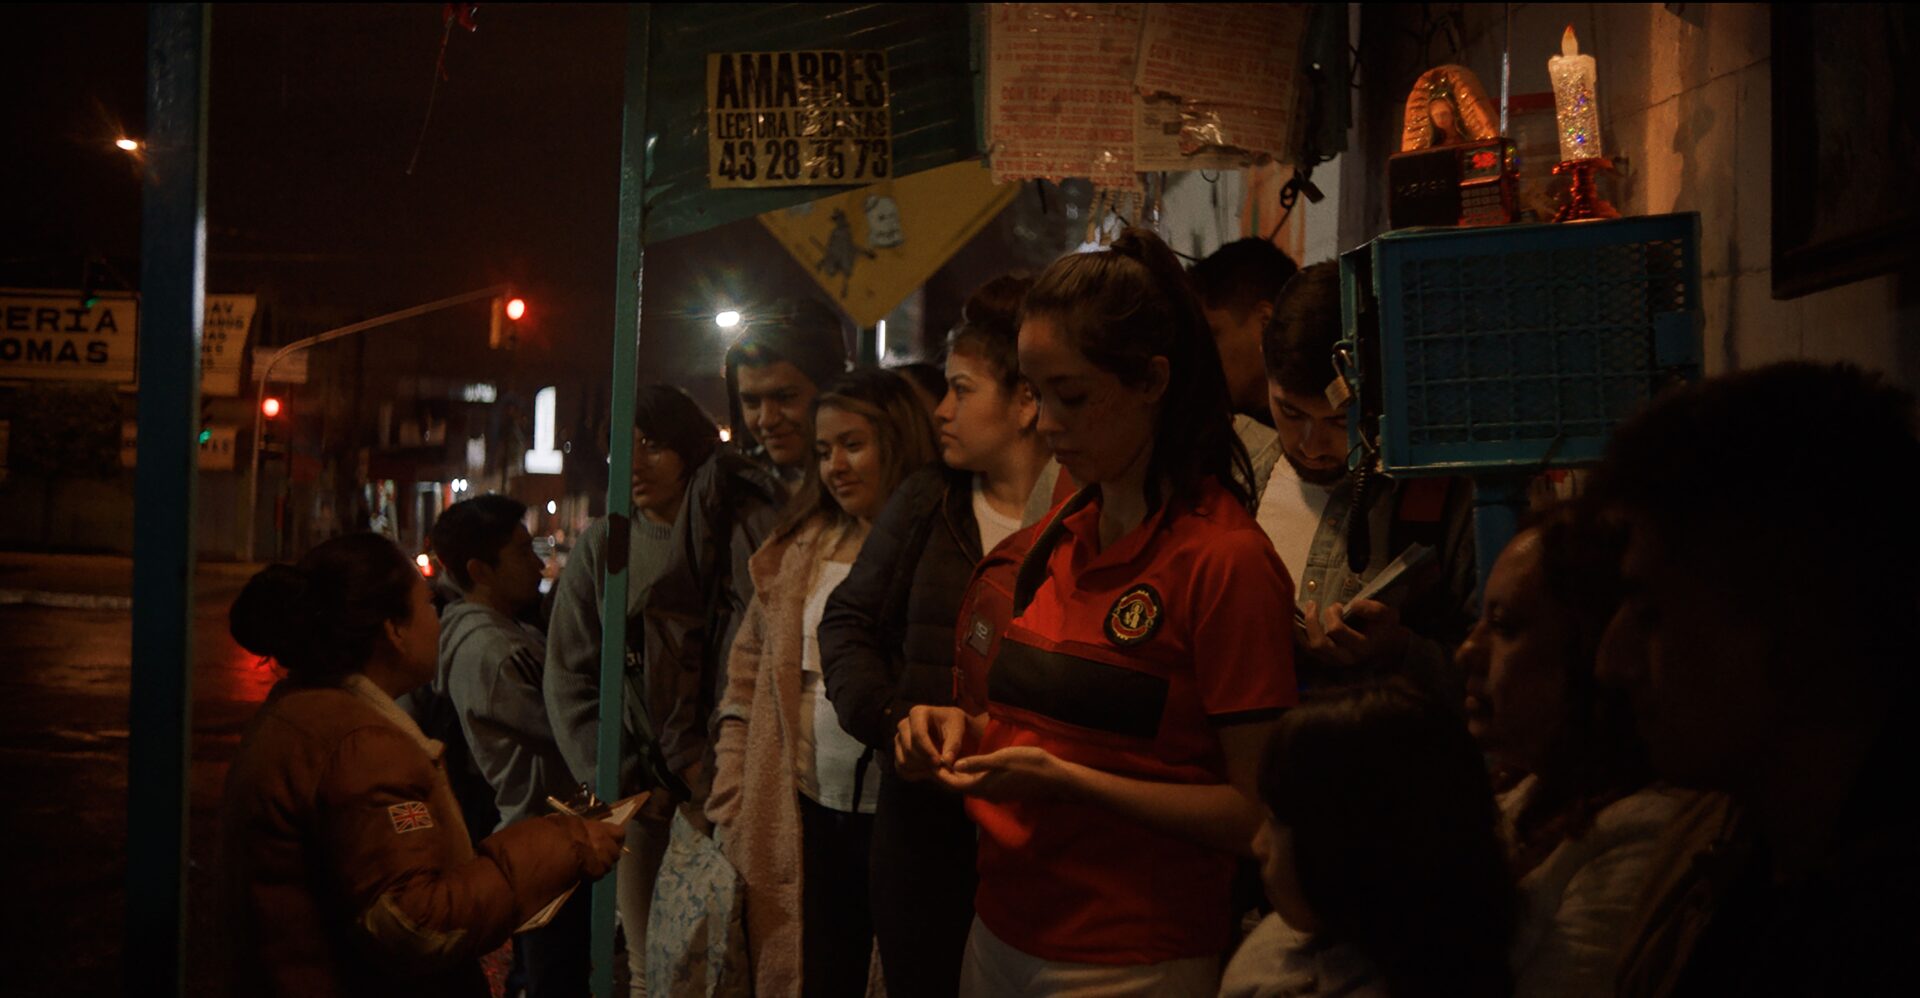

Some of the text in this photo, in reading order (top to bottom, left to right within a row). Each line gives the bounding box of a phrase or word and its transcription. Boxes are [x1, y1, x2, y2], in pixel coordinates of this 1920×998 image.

[716, 52, 886, 109] AMARRES
[717, 112, 790, 139] LECTURA
[718, 138, 888, 180] 43 28 75 73
[0, 306, 118, 333] ERIA
[0, 337, 109, 363] OMAS
